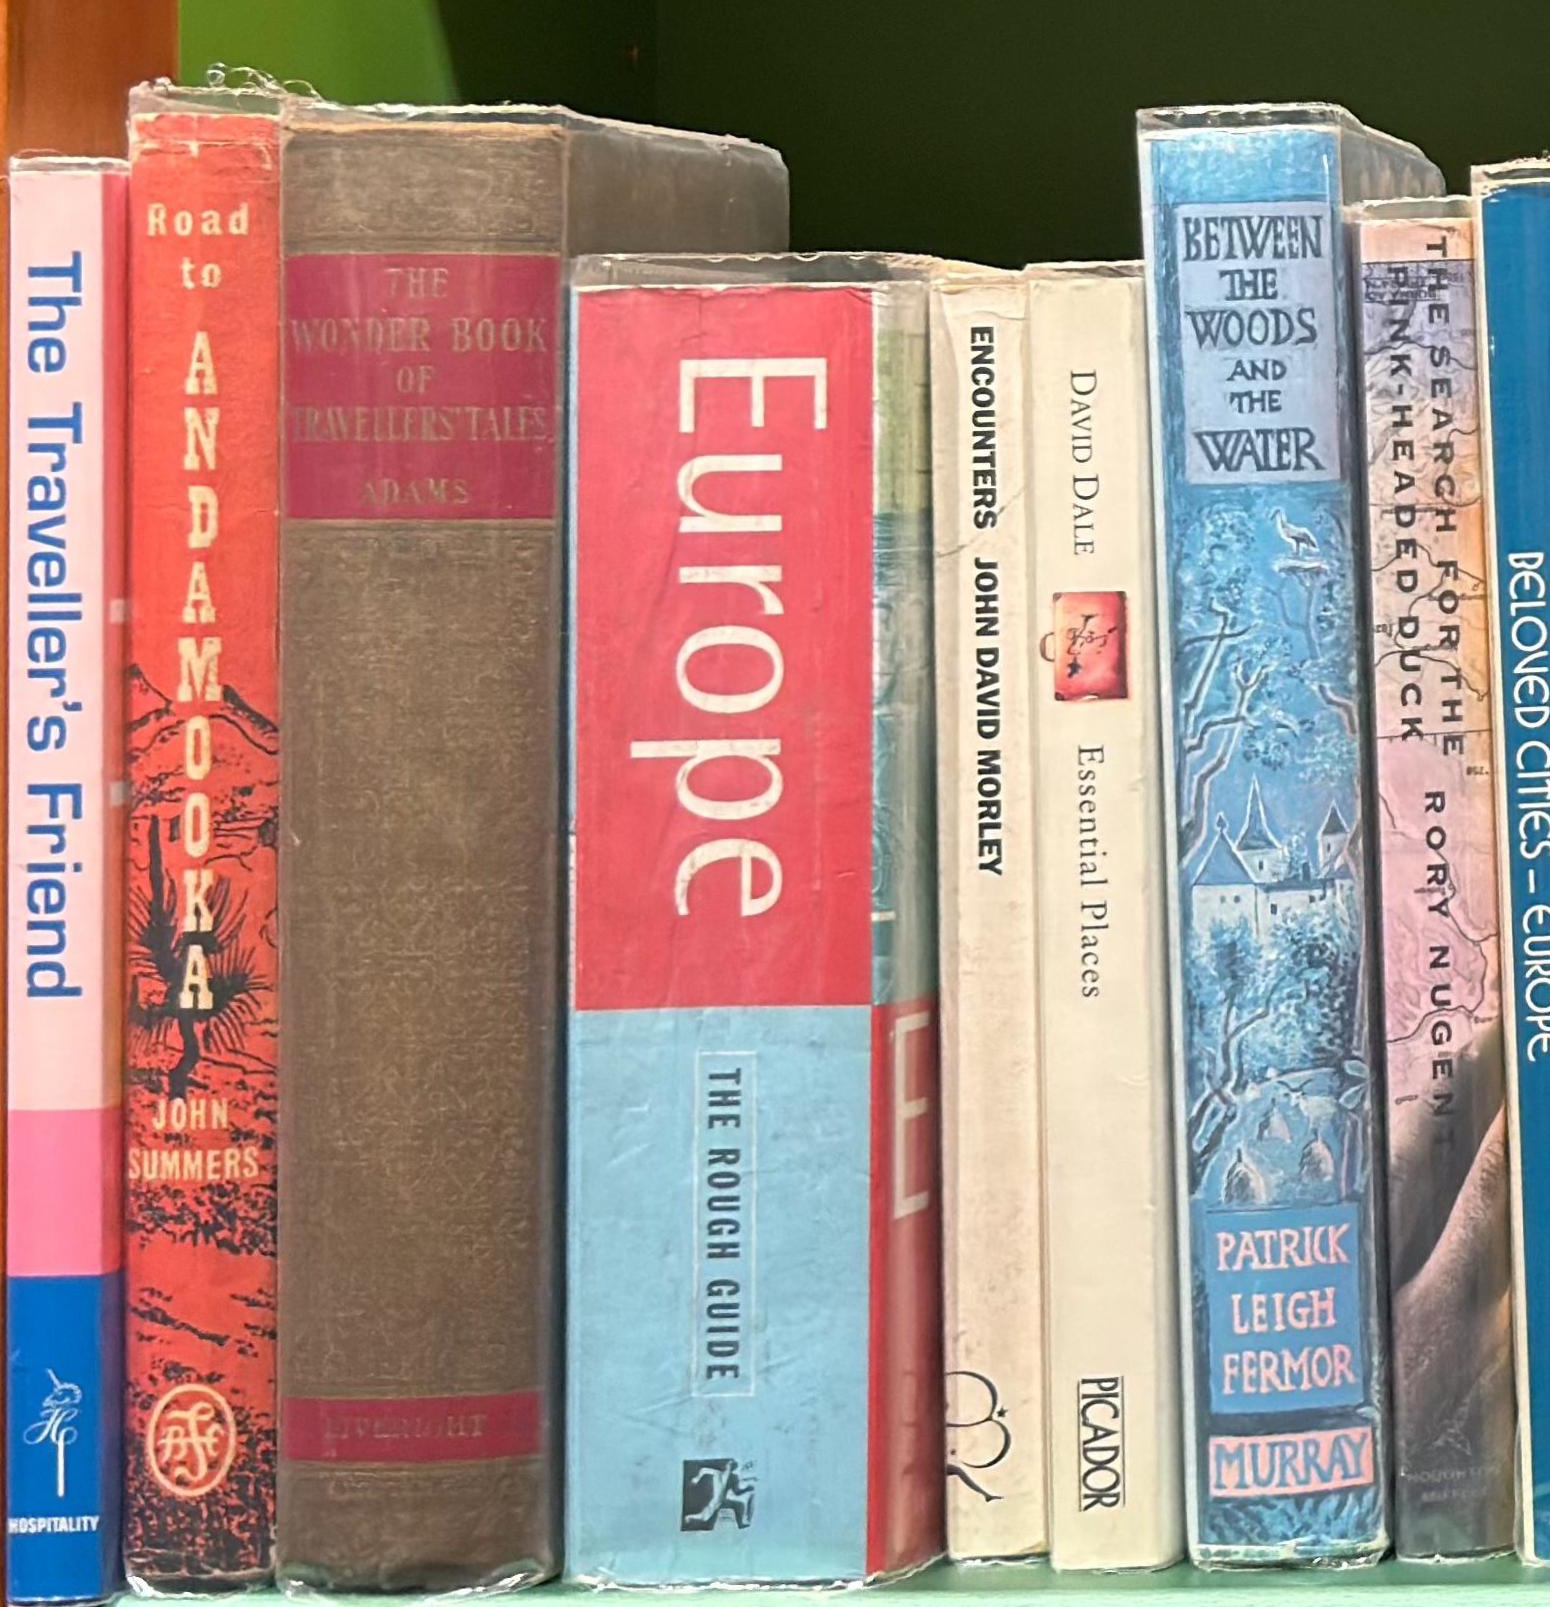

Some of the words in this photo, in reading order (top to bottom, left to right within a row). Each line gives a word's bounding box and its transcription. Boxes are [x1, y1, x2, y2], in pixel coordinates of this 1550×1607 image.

[147, 202, 250, 237] Road
[1183, 216, 1323, 261] BETWEEN
[26, 251, 83, 373] The
[180, 257, 222, 288] to
[384, 267, 448, 298] THE
[1219, 269, 1279, 301] THE
[1426, 235, 1450, 324] THE
[291, 317, 431, 354] WONDER
[451, 317, 547, 352] BOOK
[1184, 308, 1317, 348] WOODS
[396, 366, 434, 394] OF
[1227, 359, 1286, 382] AND
[1229, 391, 1281, 414] THE
[970, 326, 997, 531] ENCOUNTERS
[1194, 428, 1325, 473] WATER
[1387, 266, 1418, 595] PINK-HEADED
[1431, 346, 1457, 533] SEARCH
[362, 478, 469, 505] ADAMS
[26, 400, 83, 752] Traveller's
[974, 558, 1000, 636] JOHN
[1436, 560, 1461, 648] FOR
[177, 330, 222, 1010] ANDAMOOKA
[630, 358, 827, 917] Europe
[1398, 616, 1423, 741] DUCK
[1508, 552, 1550, 728] BELOVED
[975, 648, 1001, 739] DAVID
[1441, 669, 1465, 756] THE
[977, 750, 1003, 876] MORLEY
[1077, 745, 1106, 887] Essential
[26, 783, 83, 998] Friend
[1424, 791, 1449, 920] RORY
[1080, 901, 1109, 998] Places
[152, 1098, 229, 1131] JOHN
[708, 1068, 742, 1129] THE
[128, 1147, 260, 1182] SUMMERS
[706, 1148, 742, 1260] ROUGH
[1217, 1224, 1350, 1272] PATRICK
[705, 1281, 742, 1379] GUIDE
[1231, 1286, 1334, 1332] LEIGH
[1222, 1346, 1355, 1394] FERMOR
[1081, 1377, 1120, 1511] PICADOR
[1214, 1434, 1370, 1491] MURRAY
[8, 1516, 100, 1534] HOSPITALITY
